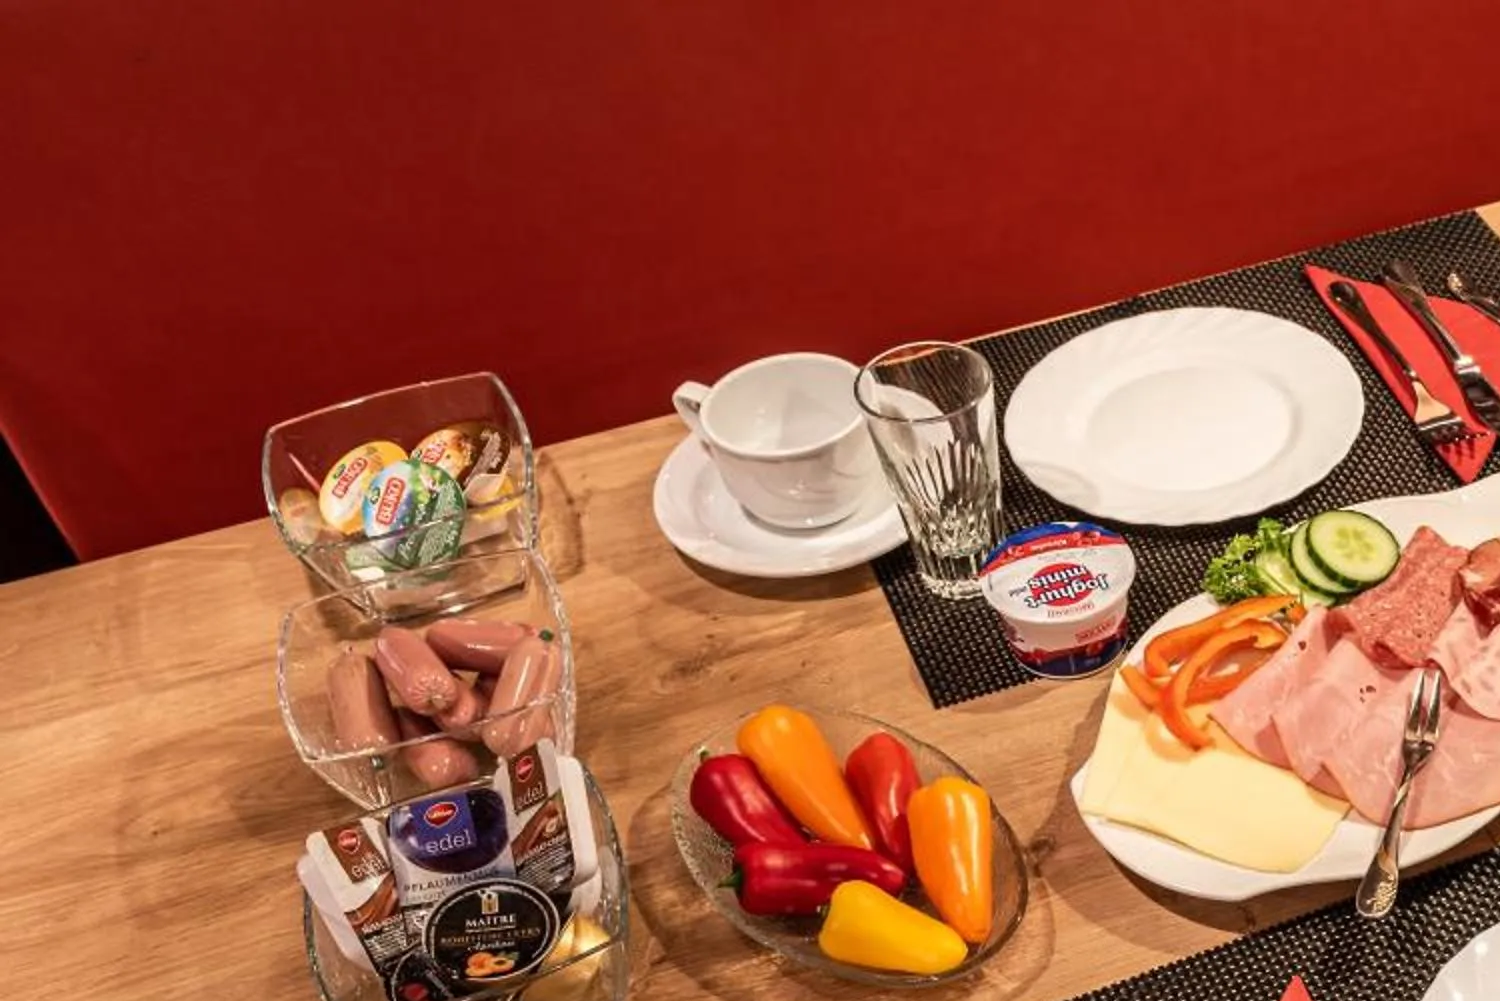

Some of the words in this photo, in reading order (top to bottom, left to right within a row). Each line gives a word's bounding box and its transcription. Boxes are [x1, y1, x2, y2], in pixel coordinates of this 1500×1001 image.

[1027, 563, 1090, 589] minis
[1024, 573, 1109, 609] Joghurt
[425, 829, 472, 854] edel
